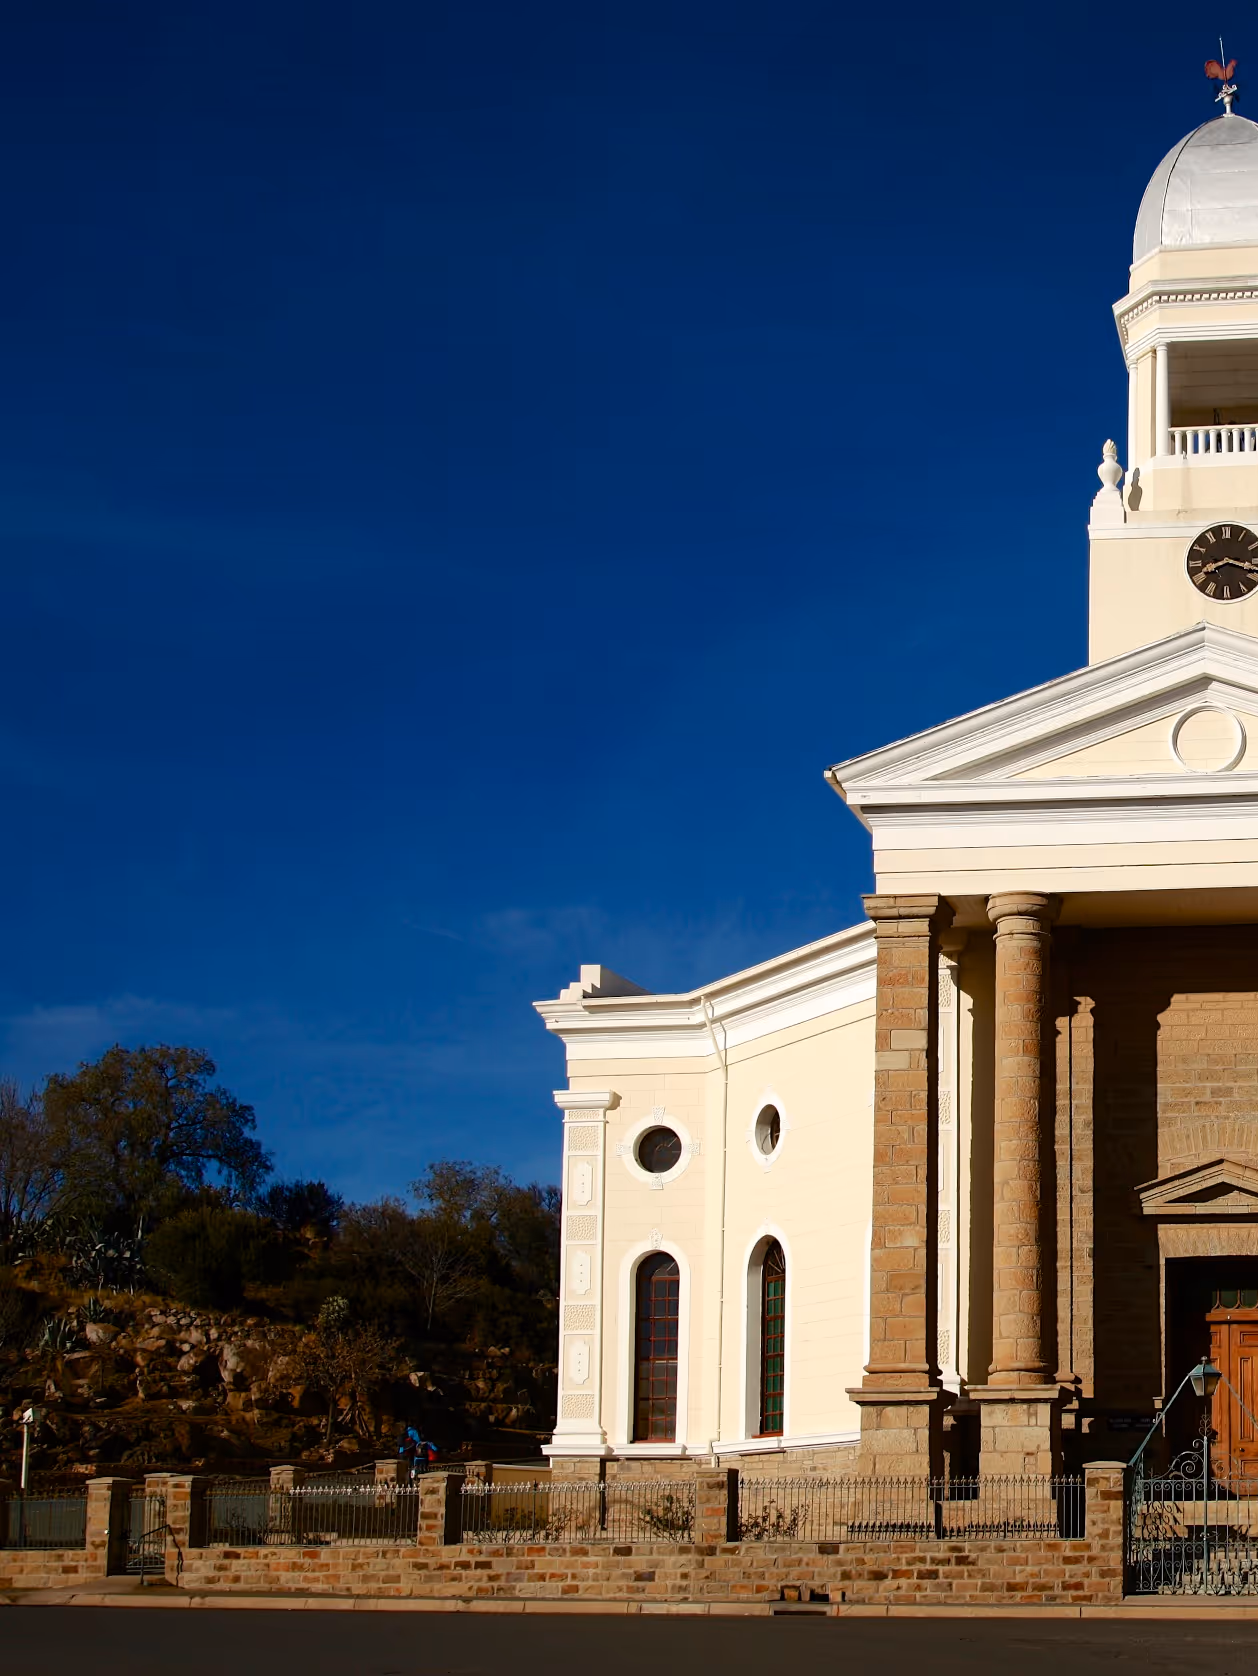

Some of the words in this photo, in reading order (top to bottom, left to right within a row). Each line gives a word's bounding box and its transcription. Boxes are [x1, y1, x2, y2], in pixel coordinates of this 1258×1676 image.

[1222, 526, 1230, 539] XII
[1238, 530, 1246, 541] I
[1193, 544, 1206, 553] X
[1238, 582, 1248, 593] V
